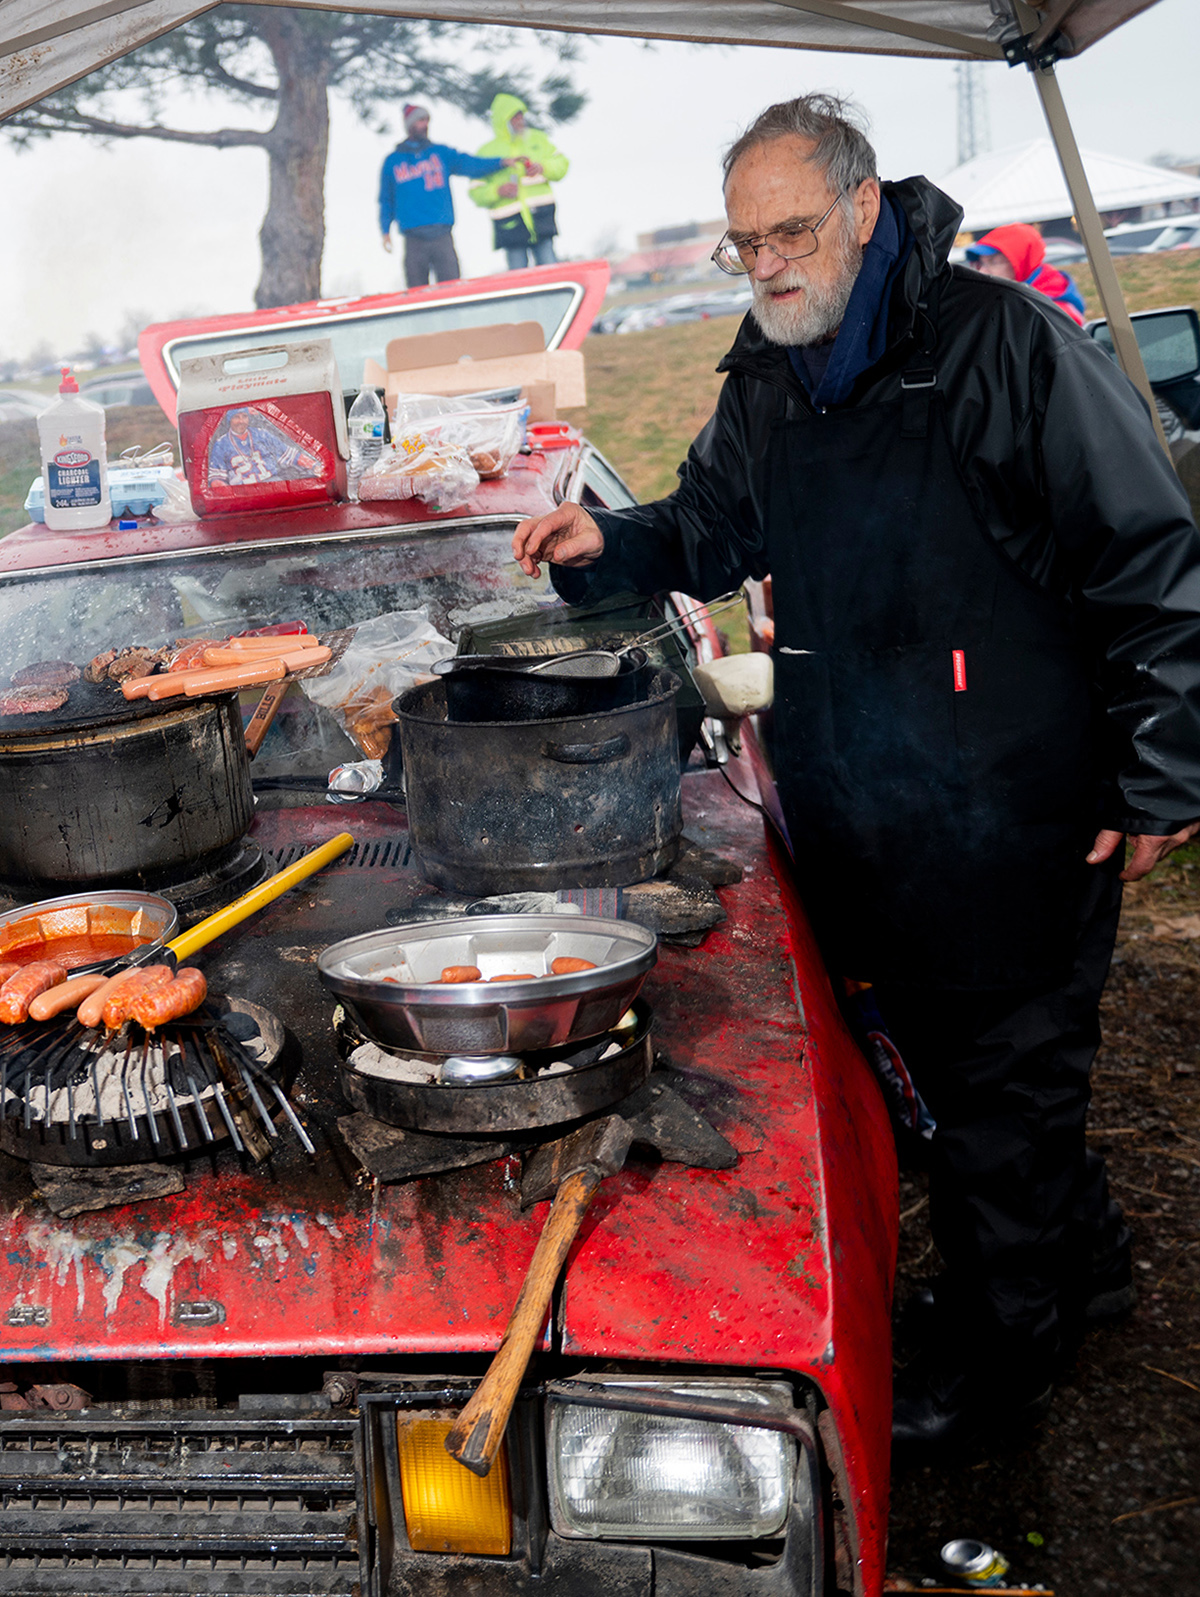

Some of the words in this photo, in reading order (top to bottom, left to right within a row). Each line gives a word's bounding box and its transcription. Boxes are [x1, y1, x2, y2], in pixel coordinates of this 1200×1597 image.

[58, 469, 89, 477] CHARCOAL
[231, 450, 272, 484] 21
[58, 475, 90, 486] LIGHTER
[255, 694, 276, 720] BILLS
